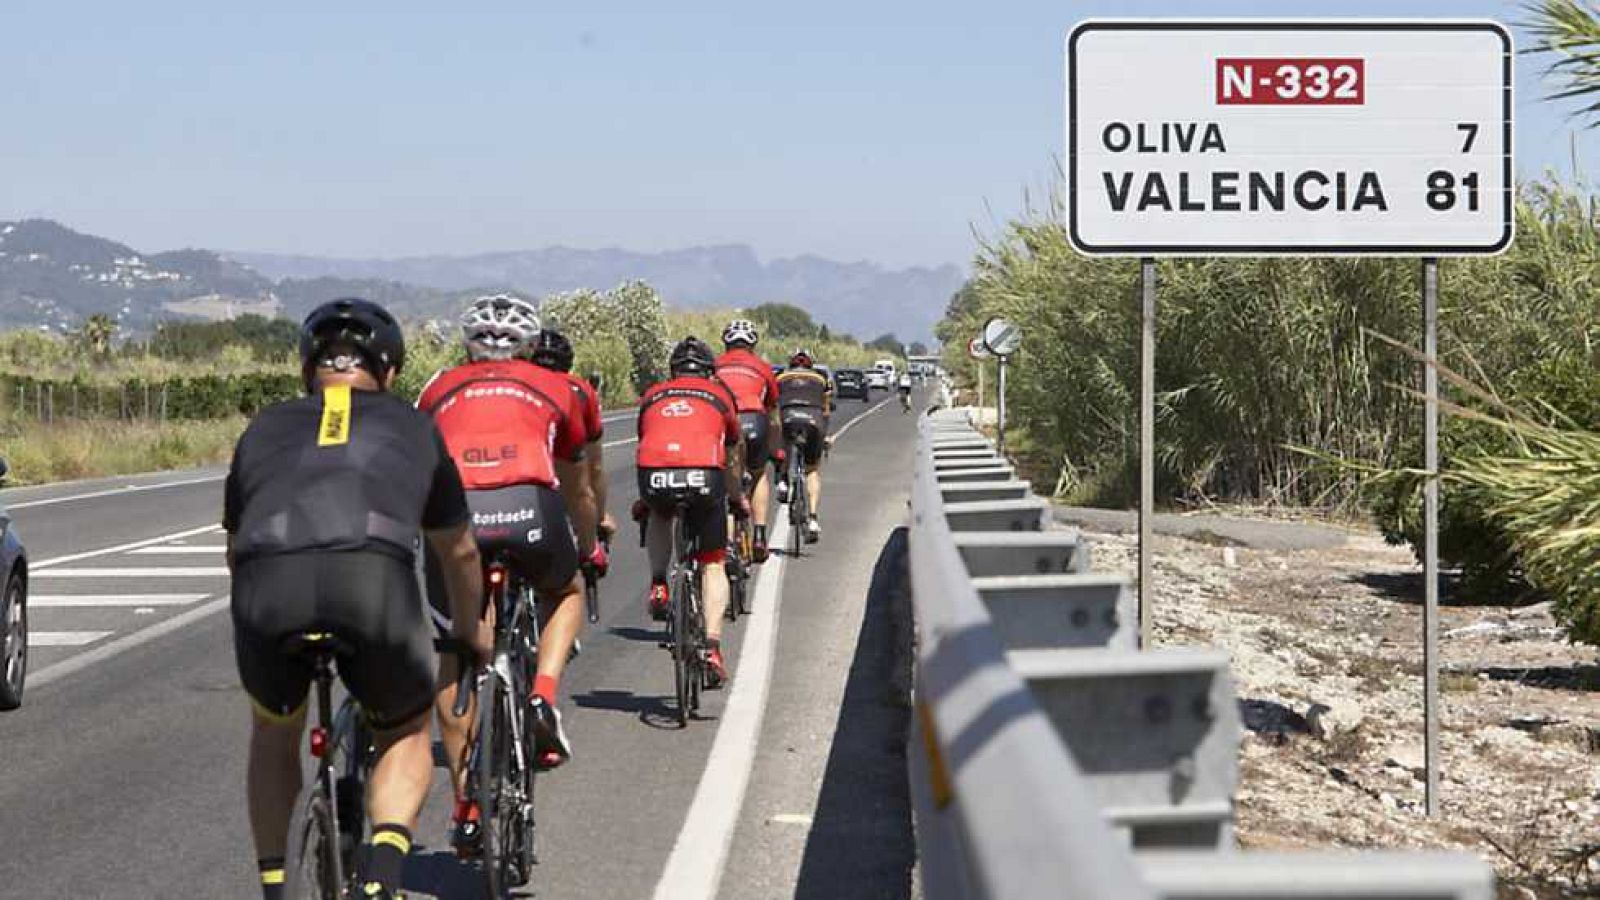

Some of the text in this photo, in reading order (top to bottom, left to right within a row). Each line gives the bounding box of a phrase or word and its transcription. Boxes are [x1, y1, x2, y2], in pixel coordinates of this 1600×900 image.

[1222, 64, 1359, 98] N-332
[1102, 122, 1480, 153] OLIVA 7
[1103, 171, 1480, 212] VALENCIA 81
